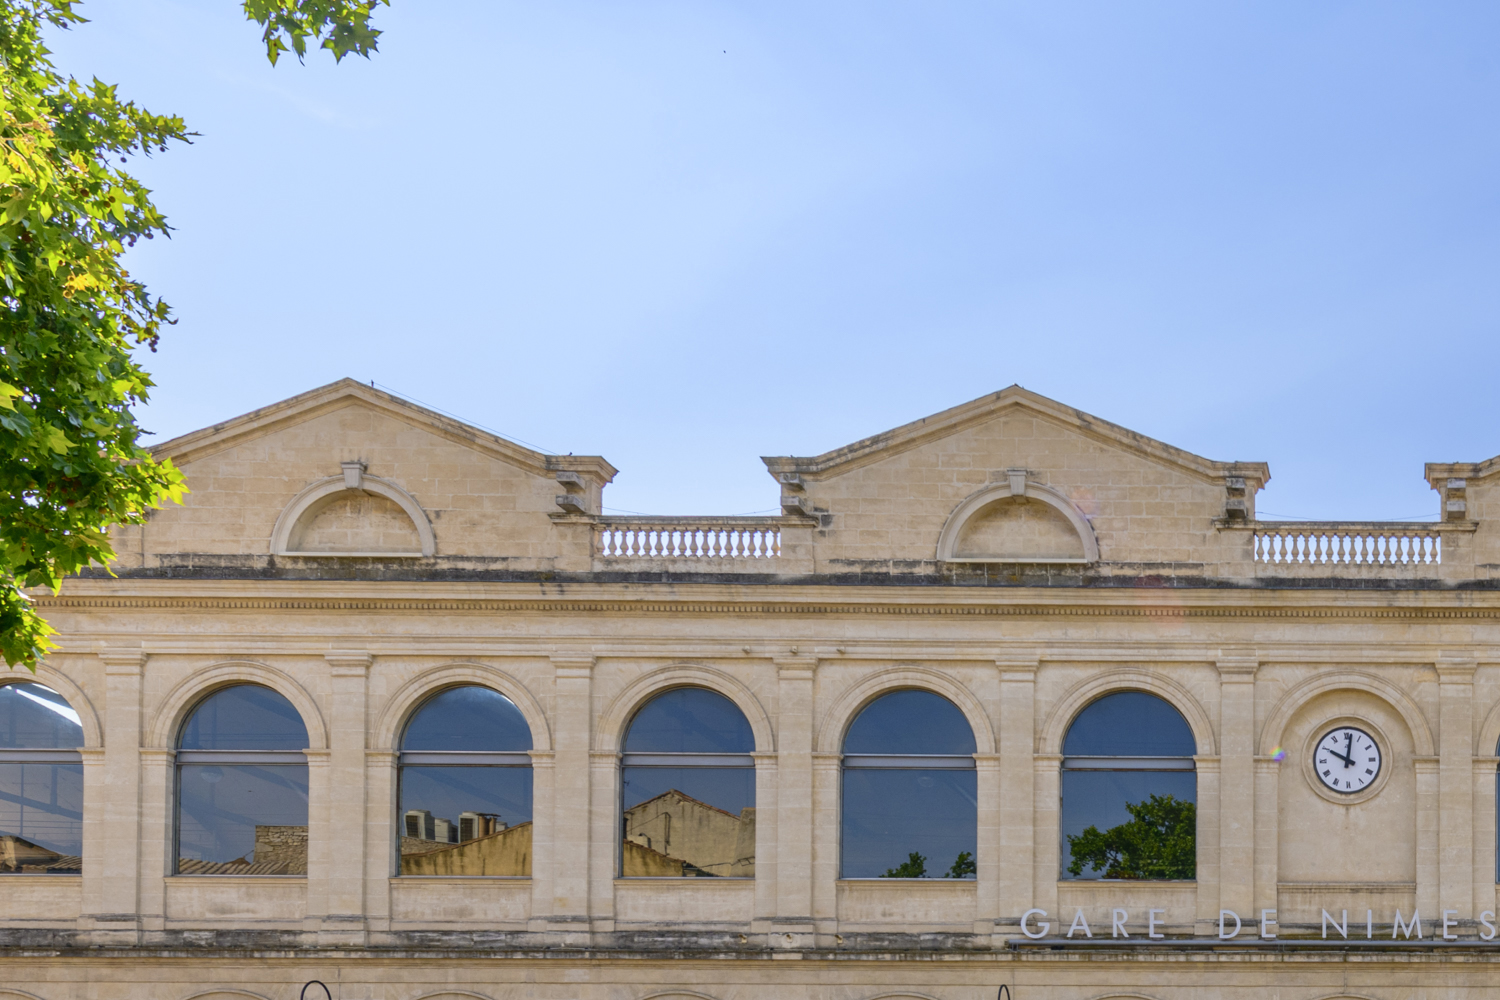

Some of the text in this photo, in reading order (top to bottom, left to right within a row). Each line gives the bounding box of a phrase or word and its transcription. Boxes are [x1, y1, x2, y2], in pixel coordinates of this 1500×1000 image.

[1020, 908, 1496, 941] GARE DE NIMES
